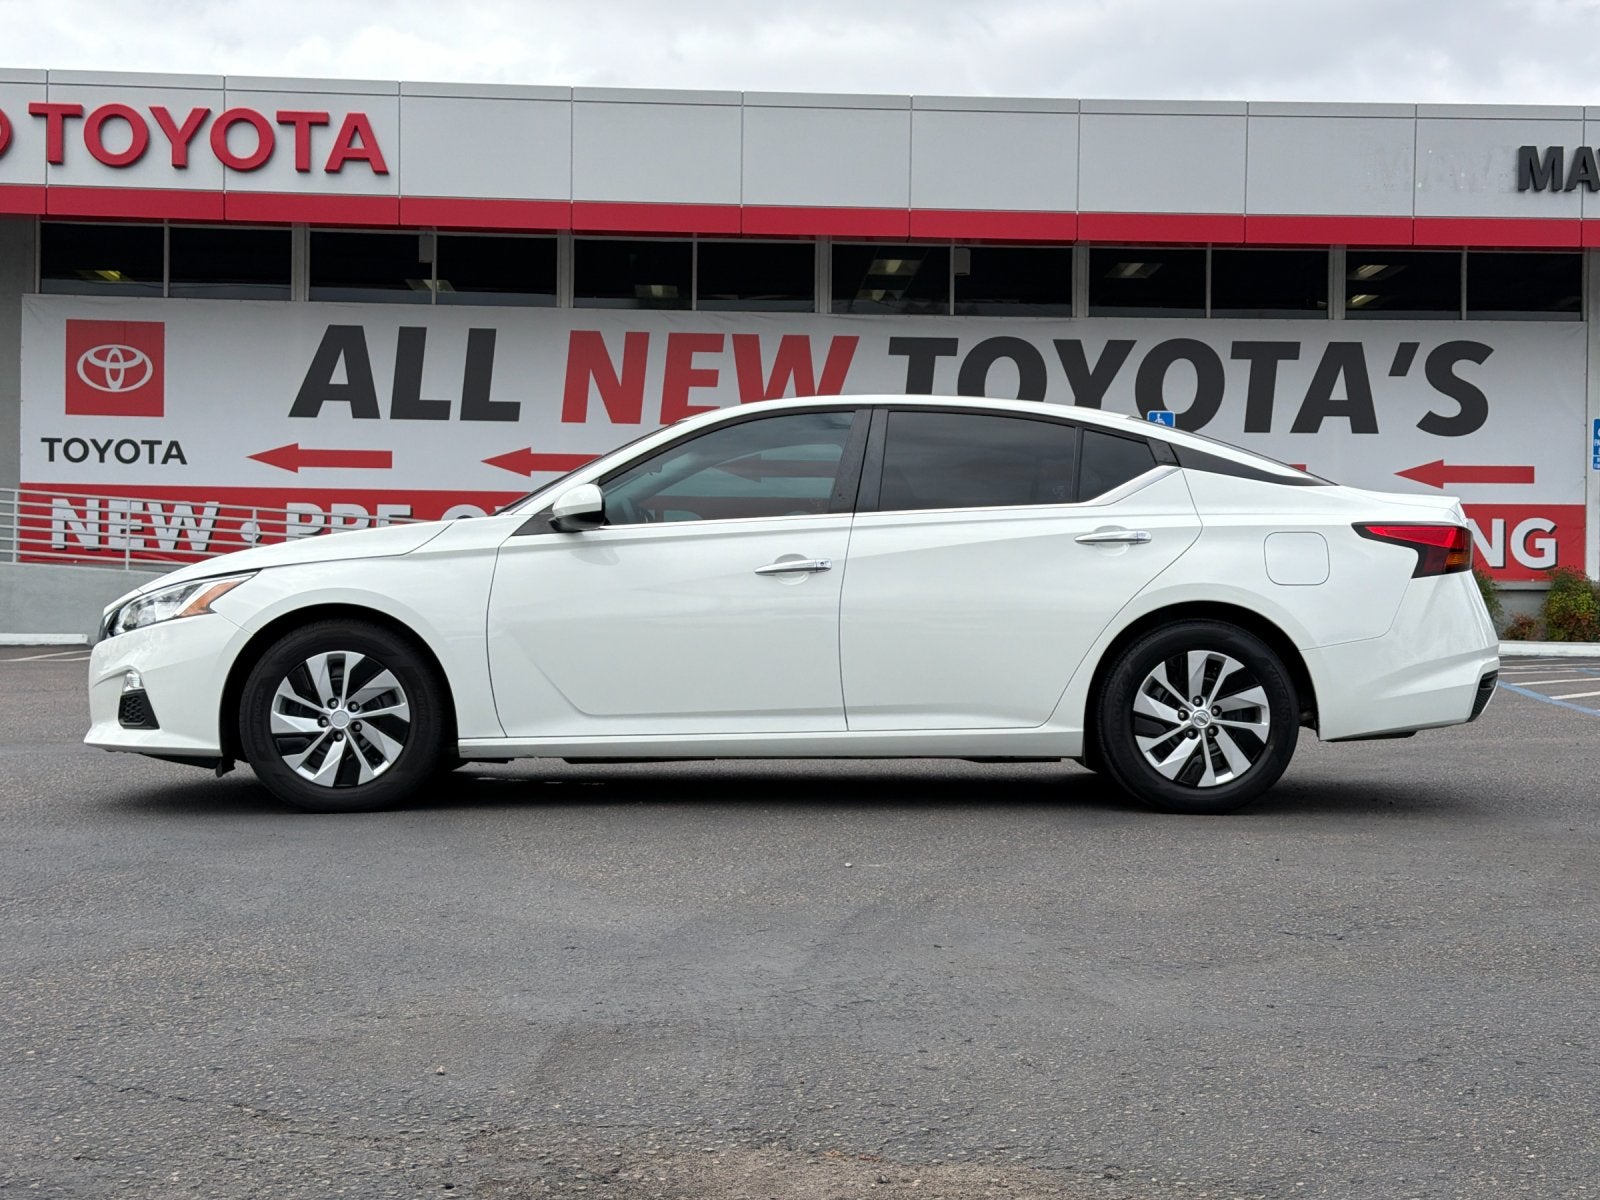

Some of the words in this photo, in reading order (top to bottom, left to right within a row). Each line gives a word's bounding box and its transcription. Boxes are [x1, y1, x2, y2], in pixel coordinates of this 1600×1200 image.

[29, 102, 390, 175] TOYOTA
[1518, 146, 1600, 193] MA
[288, 324, 521, 422] ALL
[561, 330, 859, 426] NEW
[889, 336, 1495, 437] TOYOTA'S
[41, 437, 188, 465] TOYOTA
[52, 498, 220, 551] NEW
